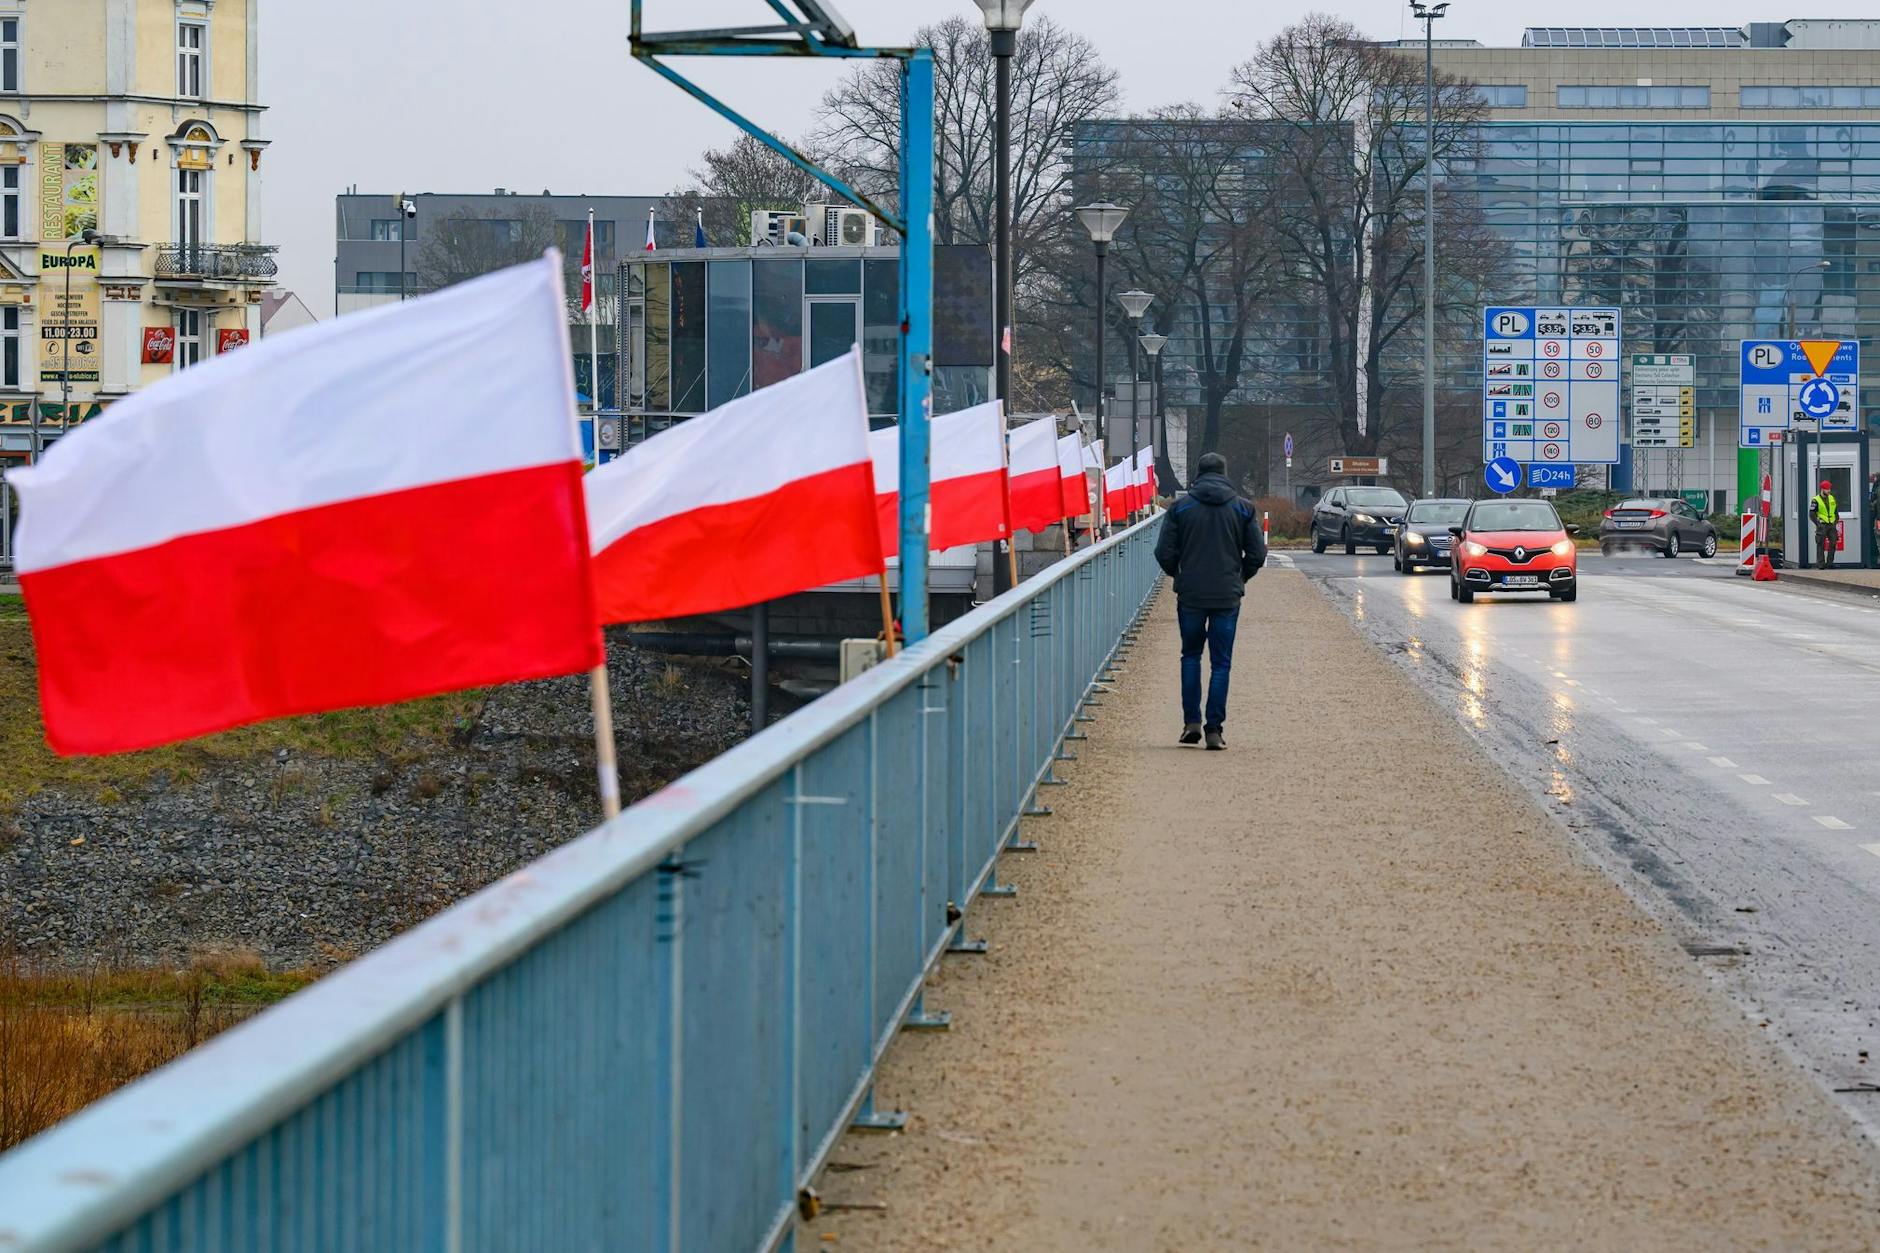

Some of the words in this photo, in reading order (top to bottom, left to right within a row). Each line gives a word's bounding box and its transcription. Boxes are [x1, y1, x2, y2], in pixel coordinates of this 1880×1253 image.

[43, 144, 62, 239] RESTAURANT
[42, 254, 96, 269] EUROPA
[1500, 316, 1521, 332] PL
[1547, 345, 1557, 353] 50
[1755, 348, 1776, 364] PL
[1791, 353, 1807, 361] Roa
[1590, 366, 1600, 374] 70
[1588, 417, 1599, 425] 80
[1551, 471, 1571, 480] 24h
